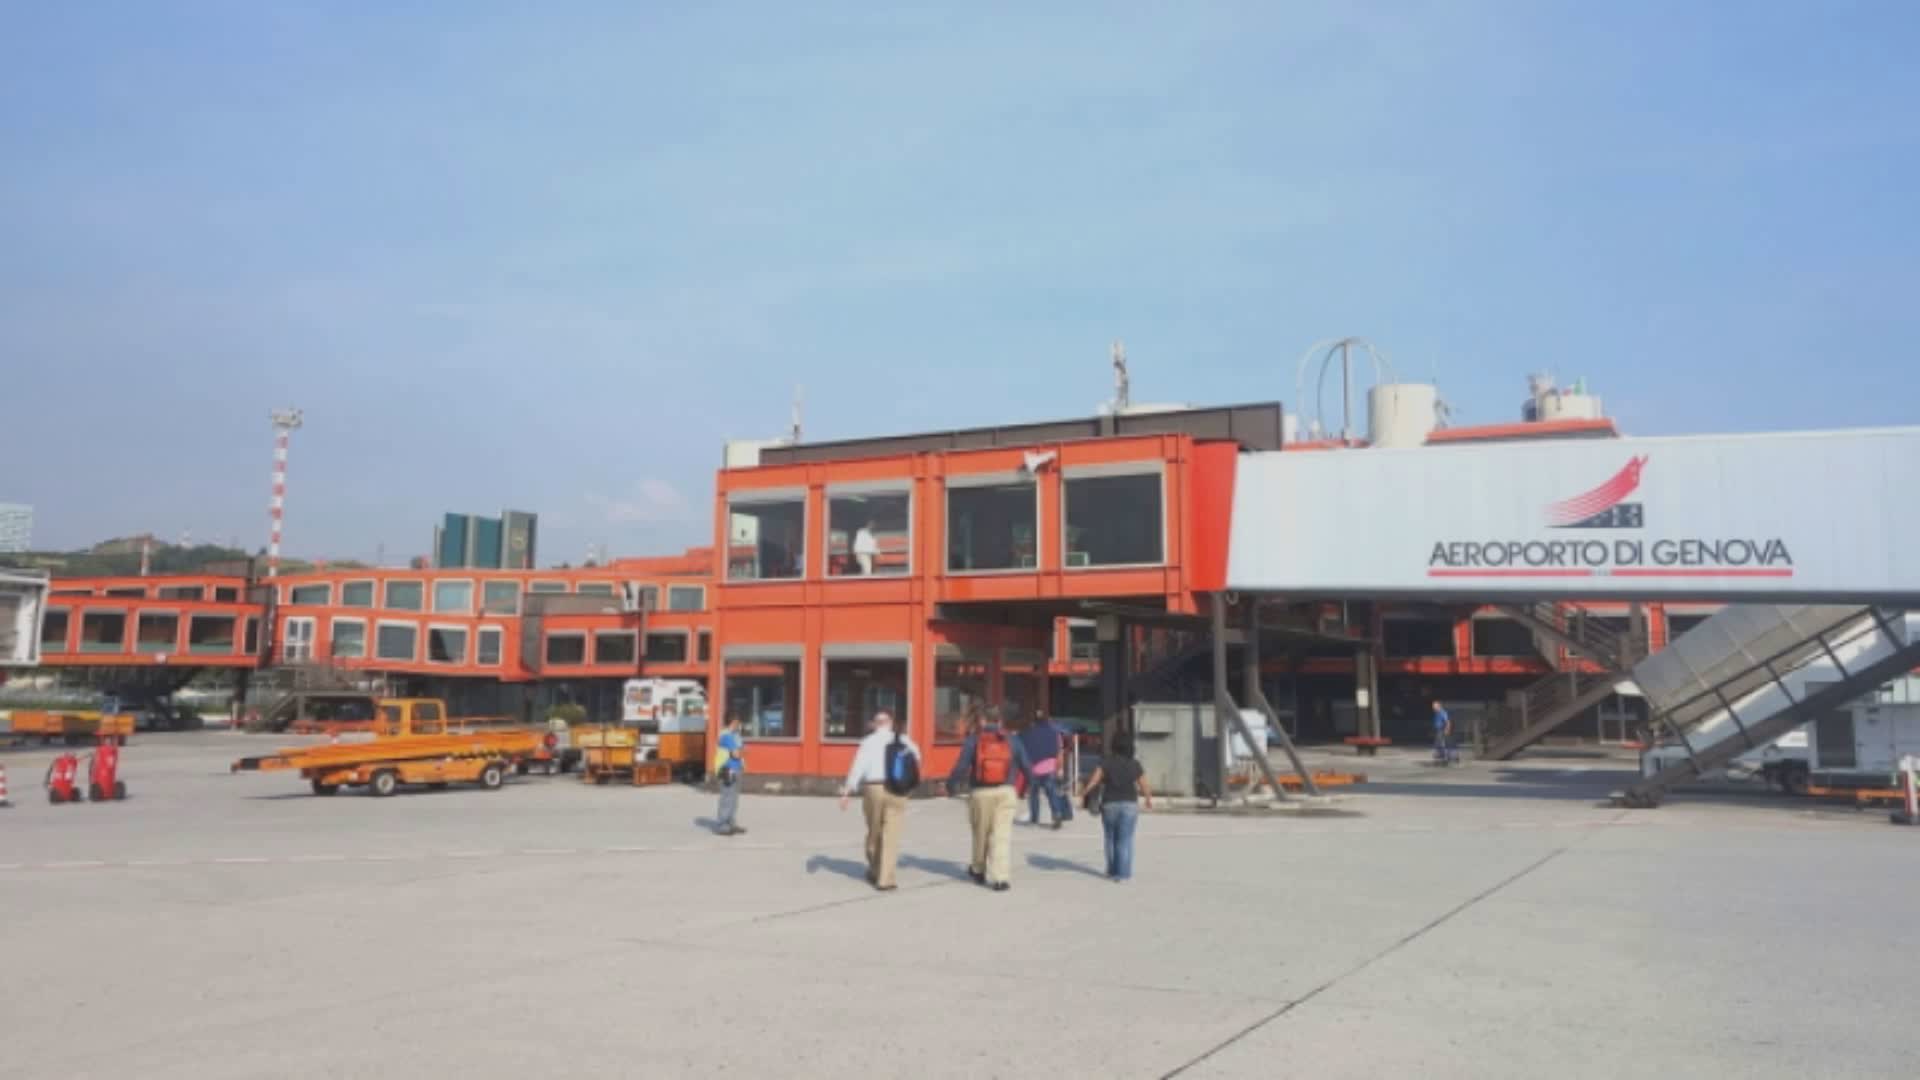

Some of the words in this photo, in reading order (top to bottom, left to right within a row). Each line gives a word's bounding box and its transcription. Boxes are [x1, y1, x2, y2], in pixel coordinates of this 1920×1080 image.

[1429, 540, 1608, 566] AEROPORTO
[1615, 540, 1643, 565] DI
[1651, 538, 1793, 565] GENOVA
